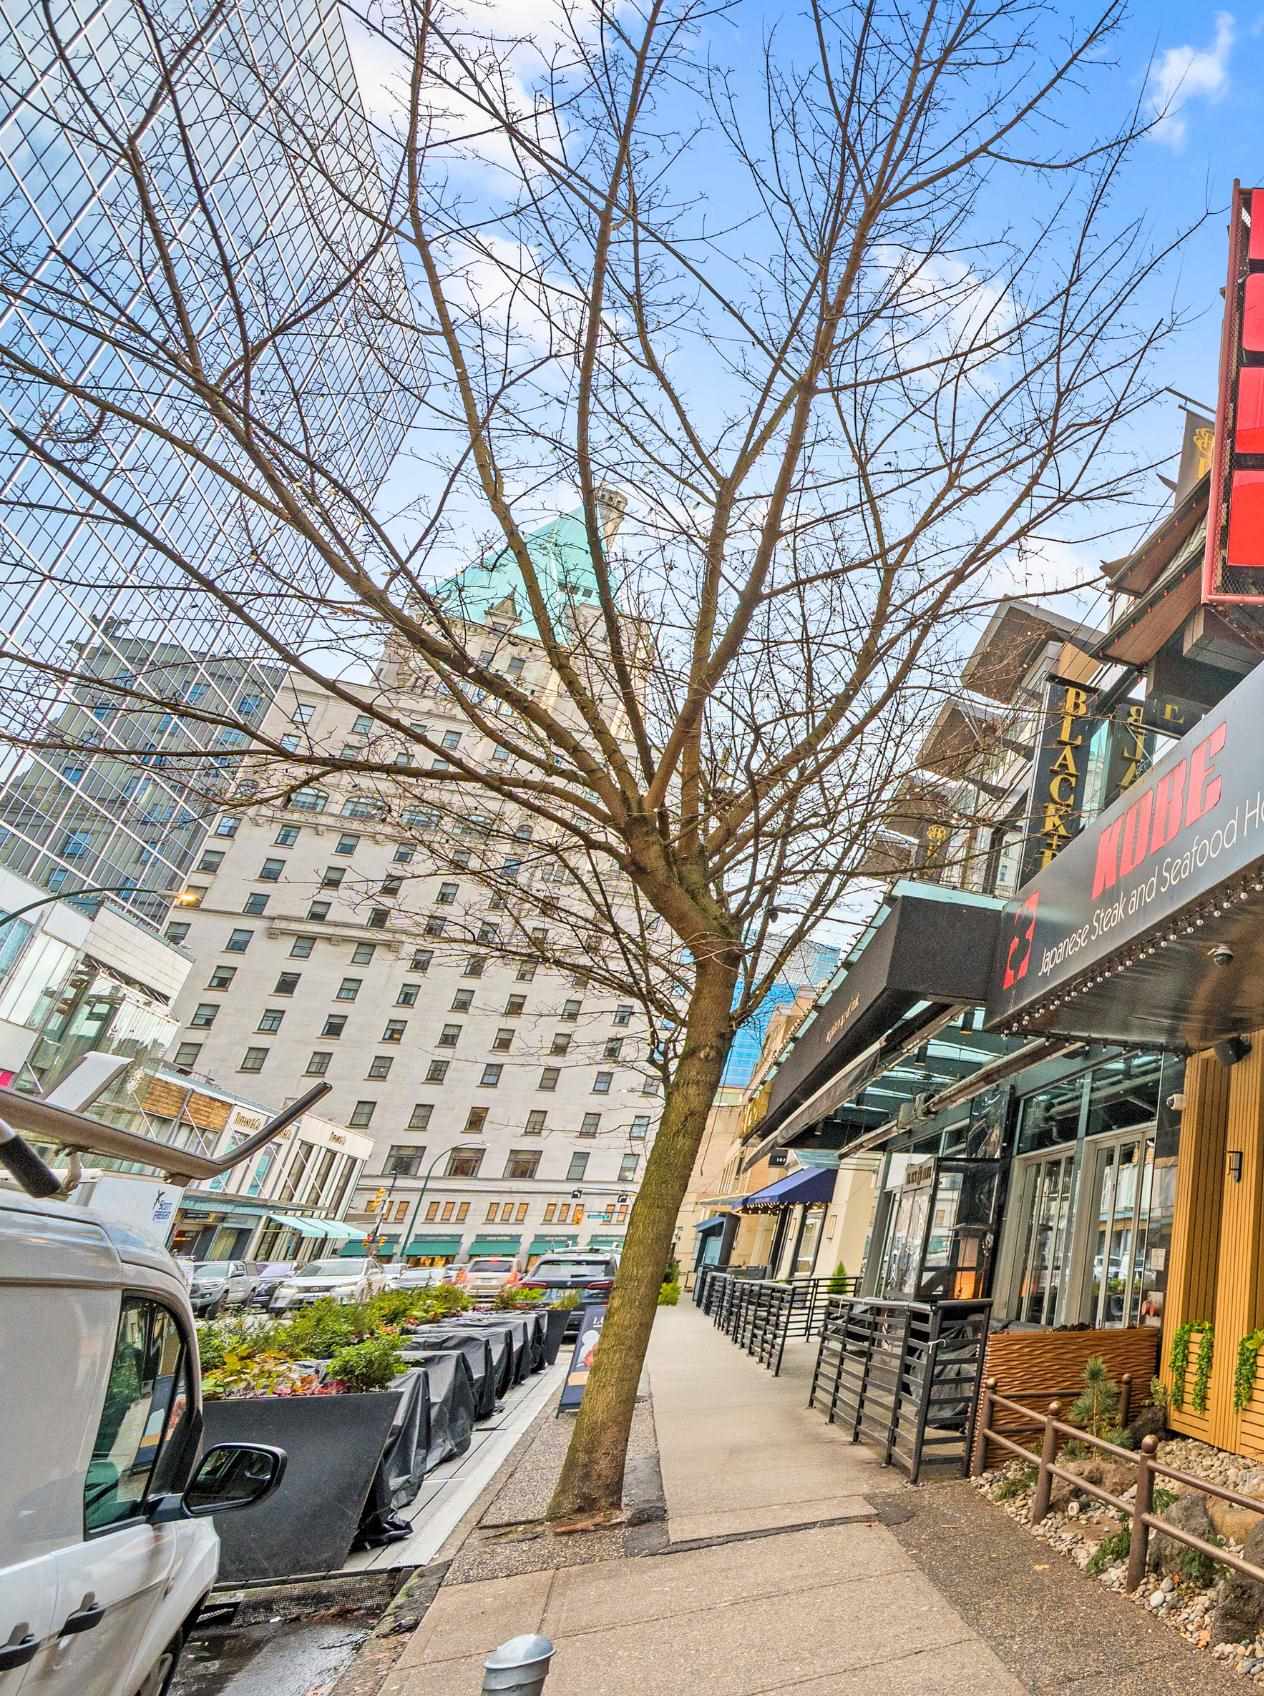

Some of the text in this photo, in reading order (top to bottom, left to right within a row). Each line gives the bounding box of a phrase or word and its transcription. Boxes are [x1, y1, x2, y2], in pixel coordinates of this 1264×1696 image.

[1038, 923, 1089, 977] Japanese
[1091, 889, 1126, 939] Steak
[1128, 875, 1157, 914] and
[1161, 806, 1239, 893] Seafood
[1091, 720, 1228, 901] KOBE
